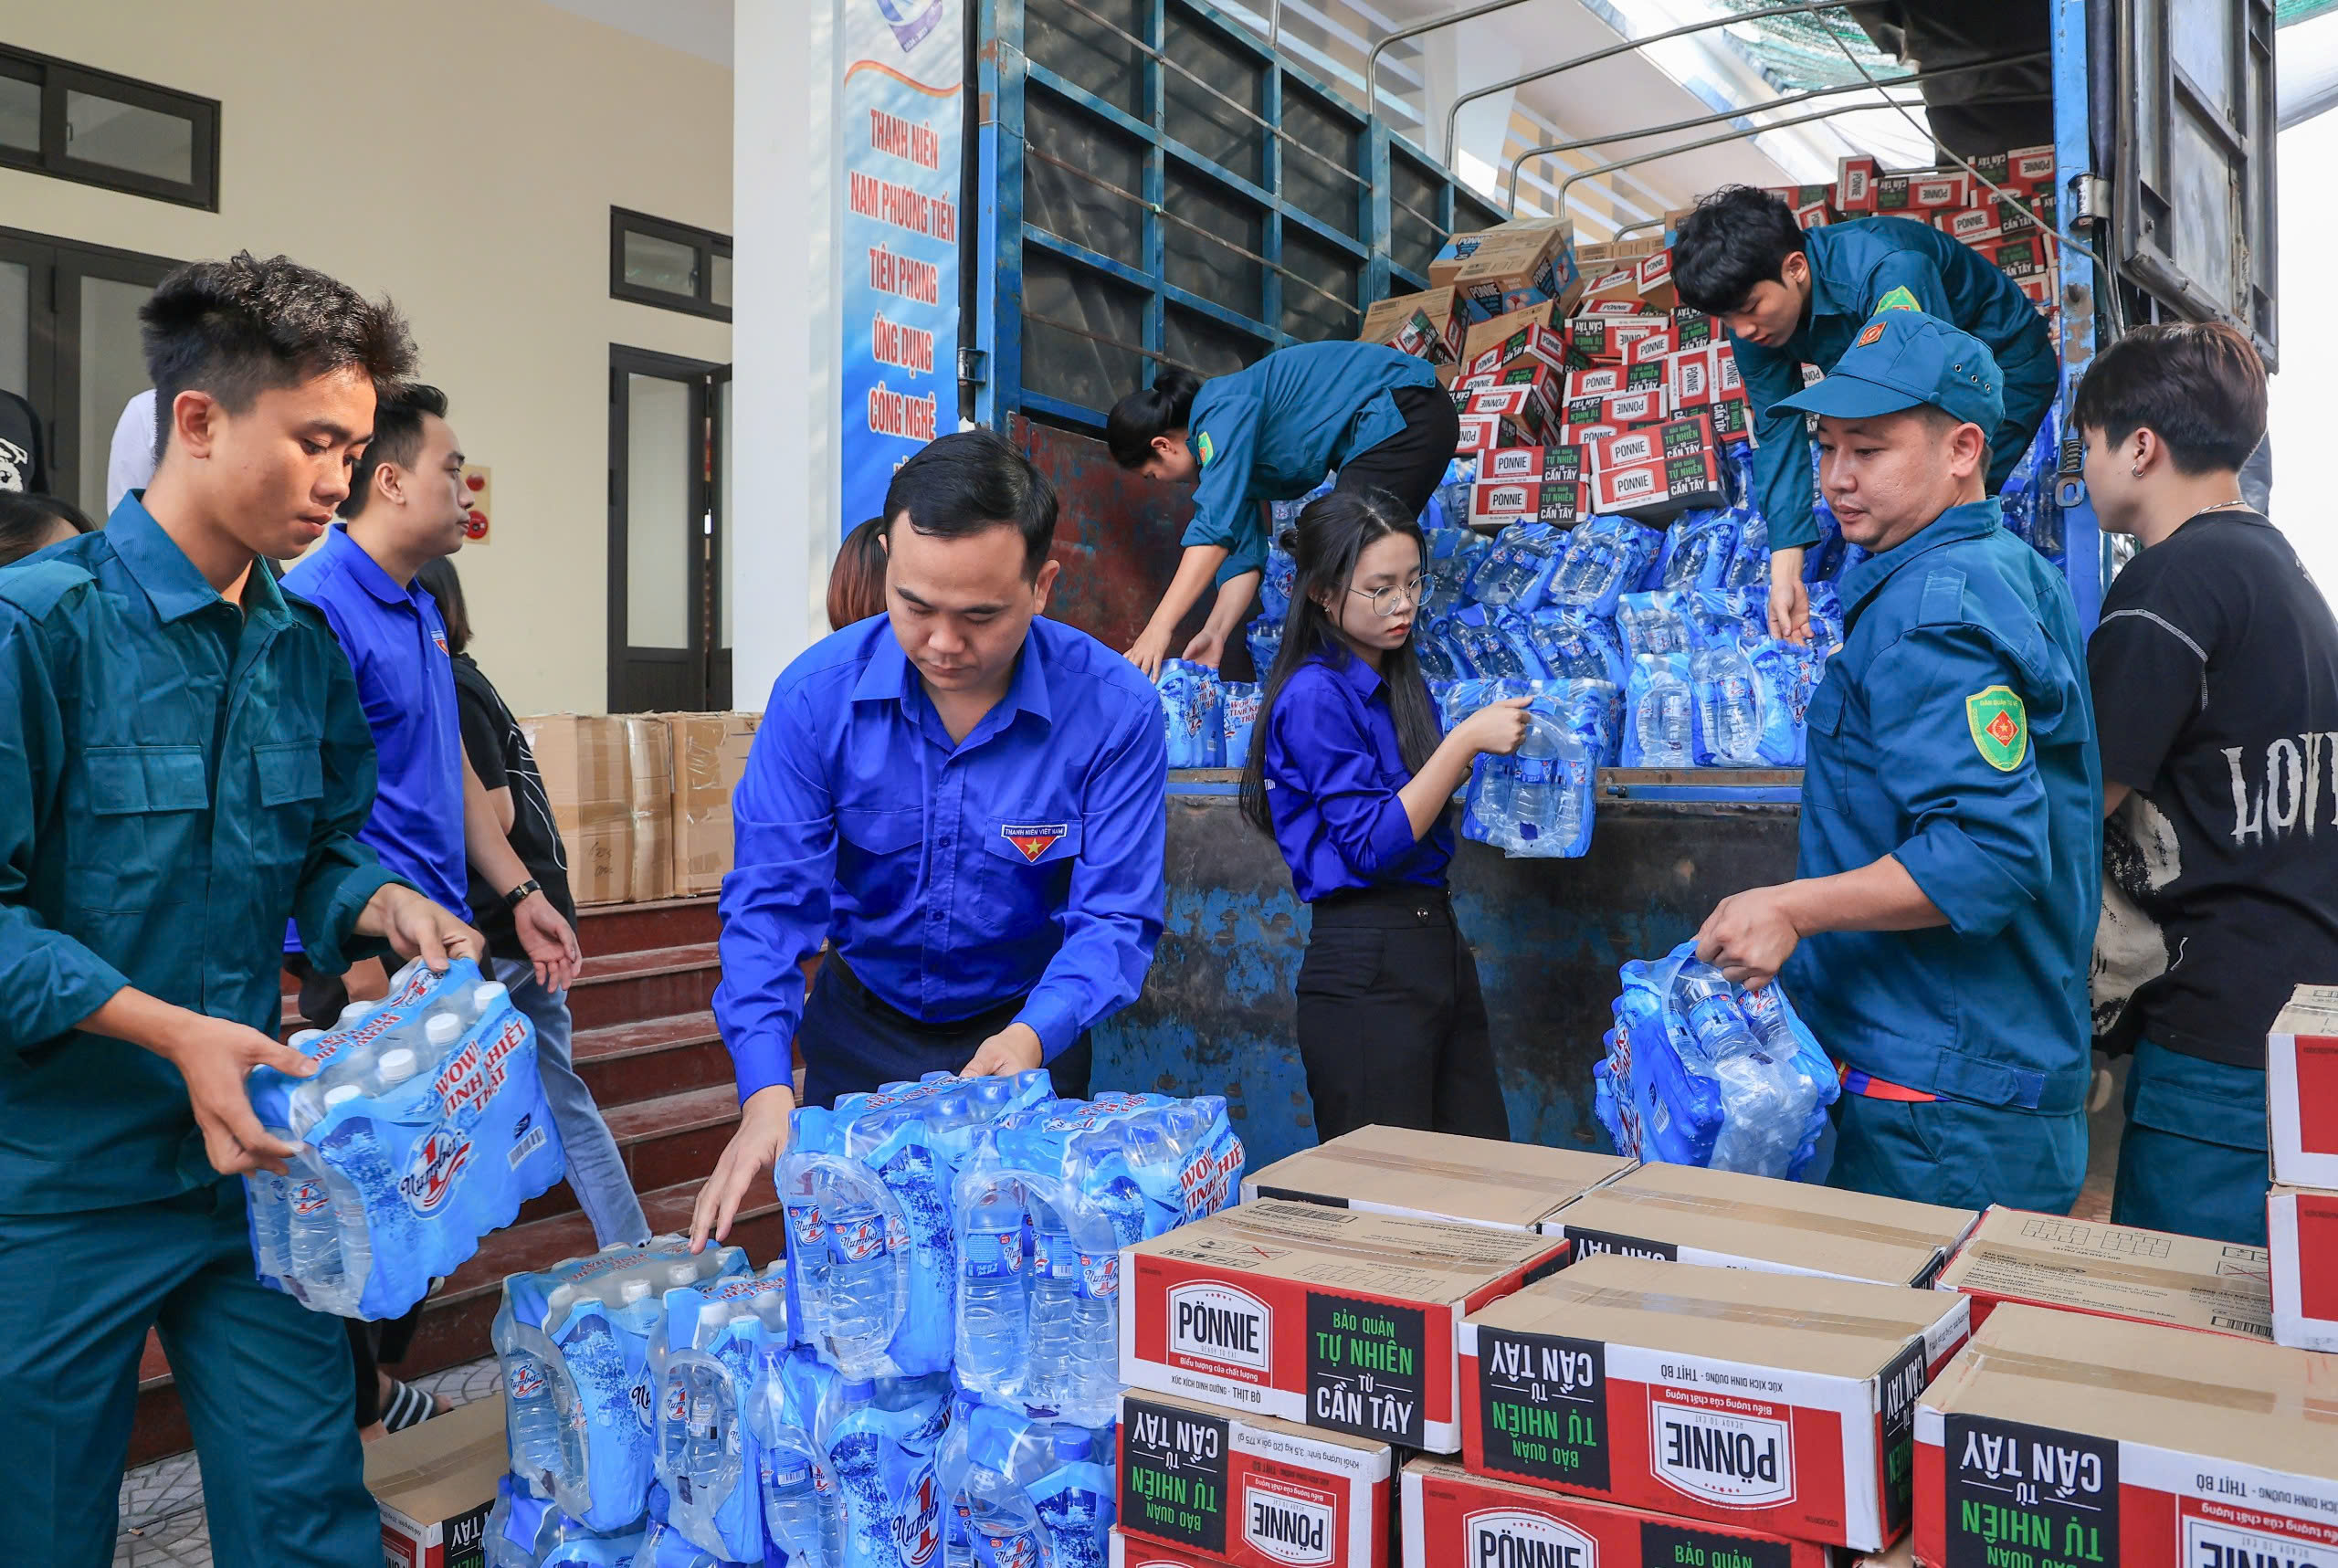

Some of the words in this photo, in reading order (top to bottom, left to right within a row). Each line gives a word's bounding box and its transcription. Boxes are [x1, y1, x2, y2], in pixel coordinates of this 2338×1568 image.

[870, 109, 908, 160] THANH
[911, 121, 939, 170] NIÊN
[850, 171, 879, 218] NAM
[882, 182, 928, 234] PHƯƠNG
[932, 190, 955, 243] TIẾN
[869, 242, 895, 292] TIÊN
[899, 257, 937, 305] PHONG
[874, 311, 899, 364] ỨNG
[901, 327, 932, 377] DỤNG
[869, 382, 902, 435] CÔNG
[840, 1228, 879, 1249] Number
[1179, 1300, 1259, 1353] PÖNNIE
[1332, 1309, 1357, 1331] BẢO
[1362, 1314, 1395, 1338] QUẢN
[1316, 1331, 1342, 1367] TỰ
[1350, 1339, 1413, 1375] NHIÊN
[1489, 1341, 1536, 1383] TÂY
[1179, 1357, 1194, 1368] Biểu
[1195, 1360, 1214, 1373] tượng
[1214, 1362, 1226, 1373] của
[1226, 1365, 1239, 1376] chất
[1240, 1369, 1259, 1382] lượng
[1542, 1347, 1593, 1394] CẦN
[1660, 1364, 1674, 1380] BÒ
[1677, 1364, 1699, 1382] THỊT
[1705, 1372, 1729, 1385] DƯỠNG
[1171, 1374, 1182, 1384] XÚC
[1183, 1376, 1195, 1387] XÍCH
[1196, 1381, 1208, 1391] DINH
[1233, 1386, 1248, 1402] THỊT
[1250, 1389, 1261, 1404] BÒ
[1358, 1373, 1374, 1393] TỪ
[1731, 1375, 1748, 1387] DINH
[1749, 1378, 1767, 1391] XÍCH
[1768, 1381, 1783, 1393] XÚC
[1531, 1383, 1548, 1403] TỪ
[1665, 1388, 1689, 1402] lượng
[1690, 1394, 1709, 1405] chất
[1710, 1397, 1725, 1408] của
[1316, 1381, 1362, 1426] CẦN
[1368, 1394, 1415, 1435] TÂY
[1726, 1398, 1751, 1412] tượng
[1754, 1404, 1773, 1415] Biểu
[1492, 1401, 1558, 1440] NHIÊN
[1567, 1408, 1597, 1447] TỰ
[1132, 1412, 1171, 1450] TÂY
[1237, 1433, 1245, 1443] g)
[1245, 1436, 1256, 1446] 175
[1176, 1420, 1218, 1464] CẦN
[1261, 1438, 1272, 1449] gói
[1273, 1440, 1284, 1450] (20
[1284, 1443, 1294, 1453] kg
[1294, 1446, 1304, 1458] 3,5
[1512, 1439, 1547, 1464] QUẢN
[1165, 1451, 1180, 1470] TỪ
[1322, 1451, 1345, 1466] lượng
[1553, 1447, 1579, 1472] BẢO
[1666, 1421, 1777, 1484] PÖNNIE
[1959, 1430, 2023, 1480] TÂY
[1344, 1458, 1360, 1469] Khối
[2032, 1443, 2101, 1499] CẦN
[1132, 1466, 1186, 1505] NHIÊN
[1255, 1478, 1270, 1489] lượng
[1282, 1485, 1293, 1496] của
[2196, 1473, 2214, 1492] BÒ
[2217, 1476, 2247, 1498] THỊT
[1193, 1477, 1217, 1513] TỰ
[1292, 1487, 1311, 1499] tượng
[1311, 1491, 1324, 1502] Biểu
[2016, 1481, 2039, 1506] TỪ
[2259, 1487, 2291, 1503] DƯỠNG
[2294, 1494, 2317, 1509] DINH
[1146, 1502, 1175, 1525] QUẢN
[2201, 1502, 2235, 1521] lượng
[2238, 1511, 2262, 1526] chất
[1179, 1510, 1201, 1534] BẢO
[1252, 1502, 1323, 1552] PÖNNIE
[1962, 1500, 2051, 1551] NHIÊN
[2263, 1516, 2284, 1531] của
[2286, 1520, 2322, 1538] tượng
[2064, 1515, 2104, 1563] TỰ
[1674, 1542, 1704, 1567] BẢO
